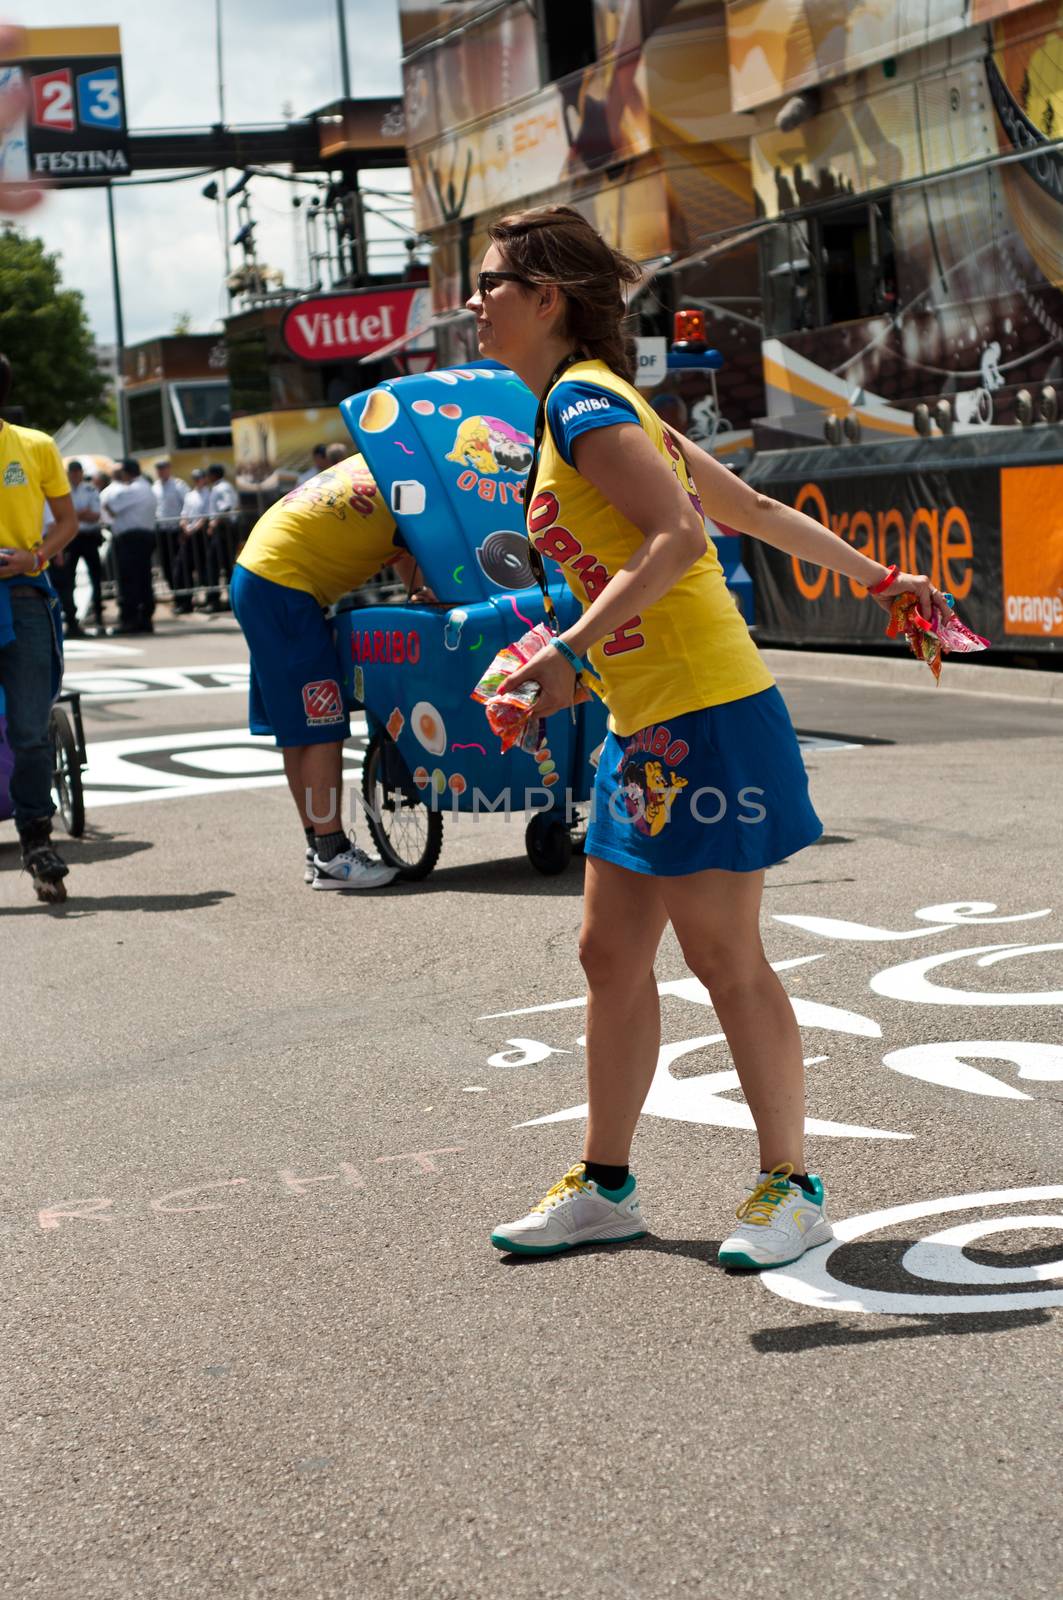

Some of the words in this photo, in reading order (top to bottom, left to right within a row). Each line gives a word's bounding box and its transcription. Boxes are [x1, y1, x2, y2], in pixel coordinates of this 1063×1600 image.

[42, 80, 74, 120] 2
[88, 79, 121, 120] 3
[34, 149, 129, 172] FESTINA
[294, 305, 395, 347] Vittel
[560, 396, 611, 425] HARIBO
[1007, 595, 1063, 633] orange
[350, 629, 421, 666] HARIBO
